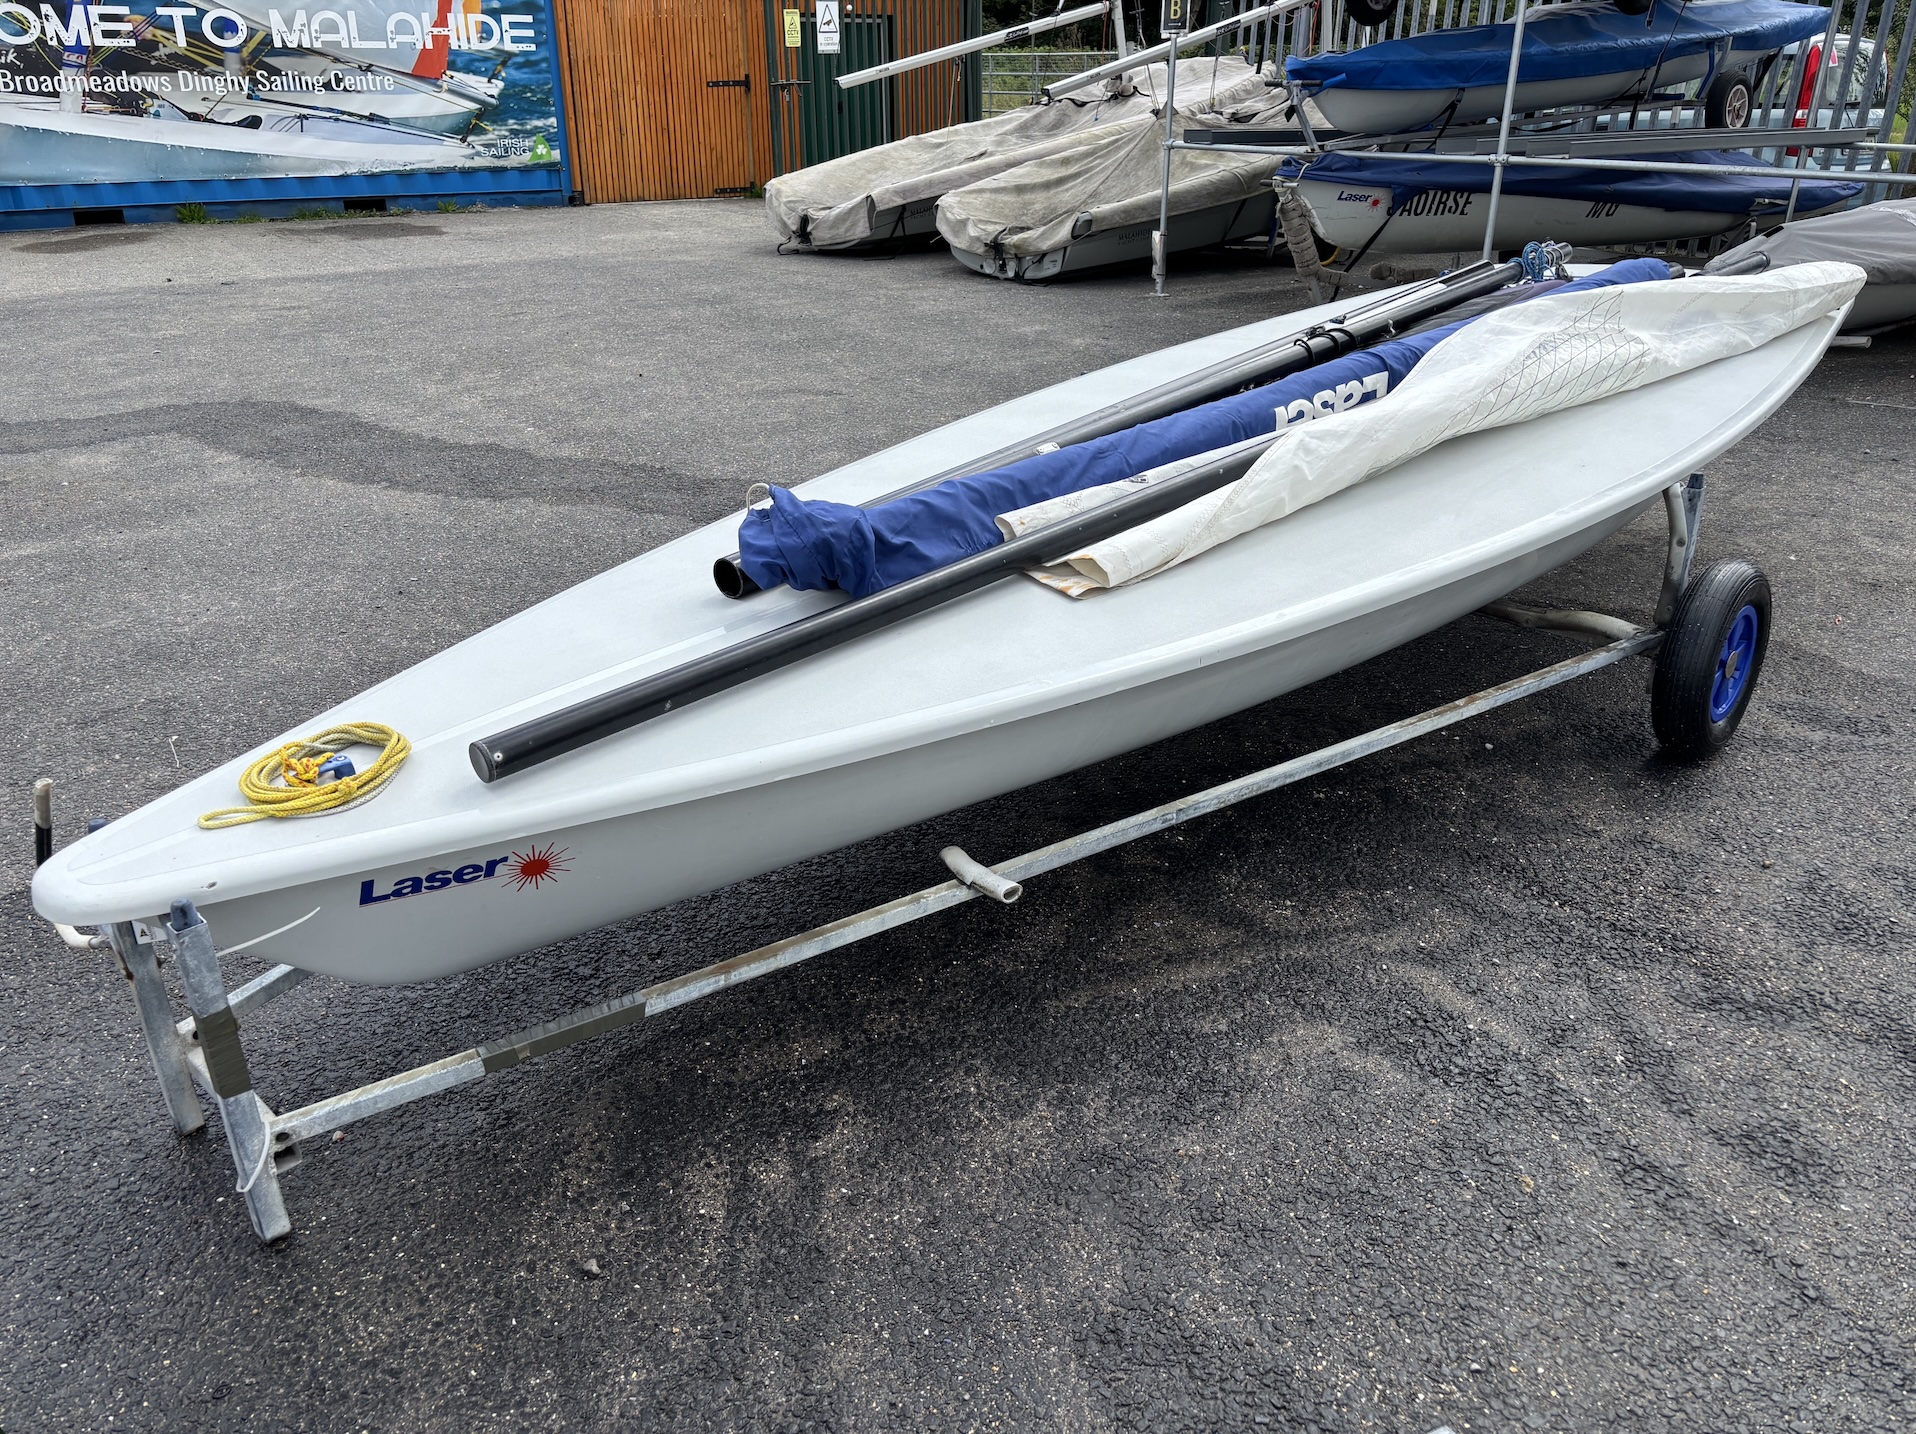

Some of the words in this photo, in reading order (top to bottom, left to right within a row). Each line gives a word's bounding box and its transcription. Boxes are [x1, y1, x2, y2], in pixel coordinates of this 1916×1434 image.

[1170, 0, 1182, 20] B
[0, 3, 137, 47] OME
[156, 7, 248, 48] TO
[268, 9, 537, 51] MALAHIDE
[0, 70, 173, 92] Broadmeadows
[178, 70, 250, 95] Dinghy
[256, 70, 326, 95] Sailing
[330, 70, 395, 91] Centre
[481, 147, 530, 157] SAILING
[497, 138, 529, 148] IRISH
[1337, 190, 1373, 202] Laser
[359, 855, 510, 906] Laser
